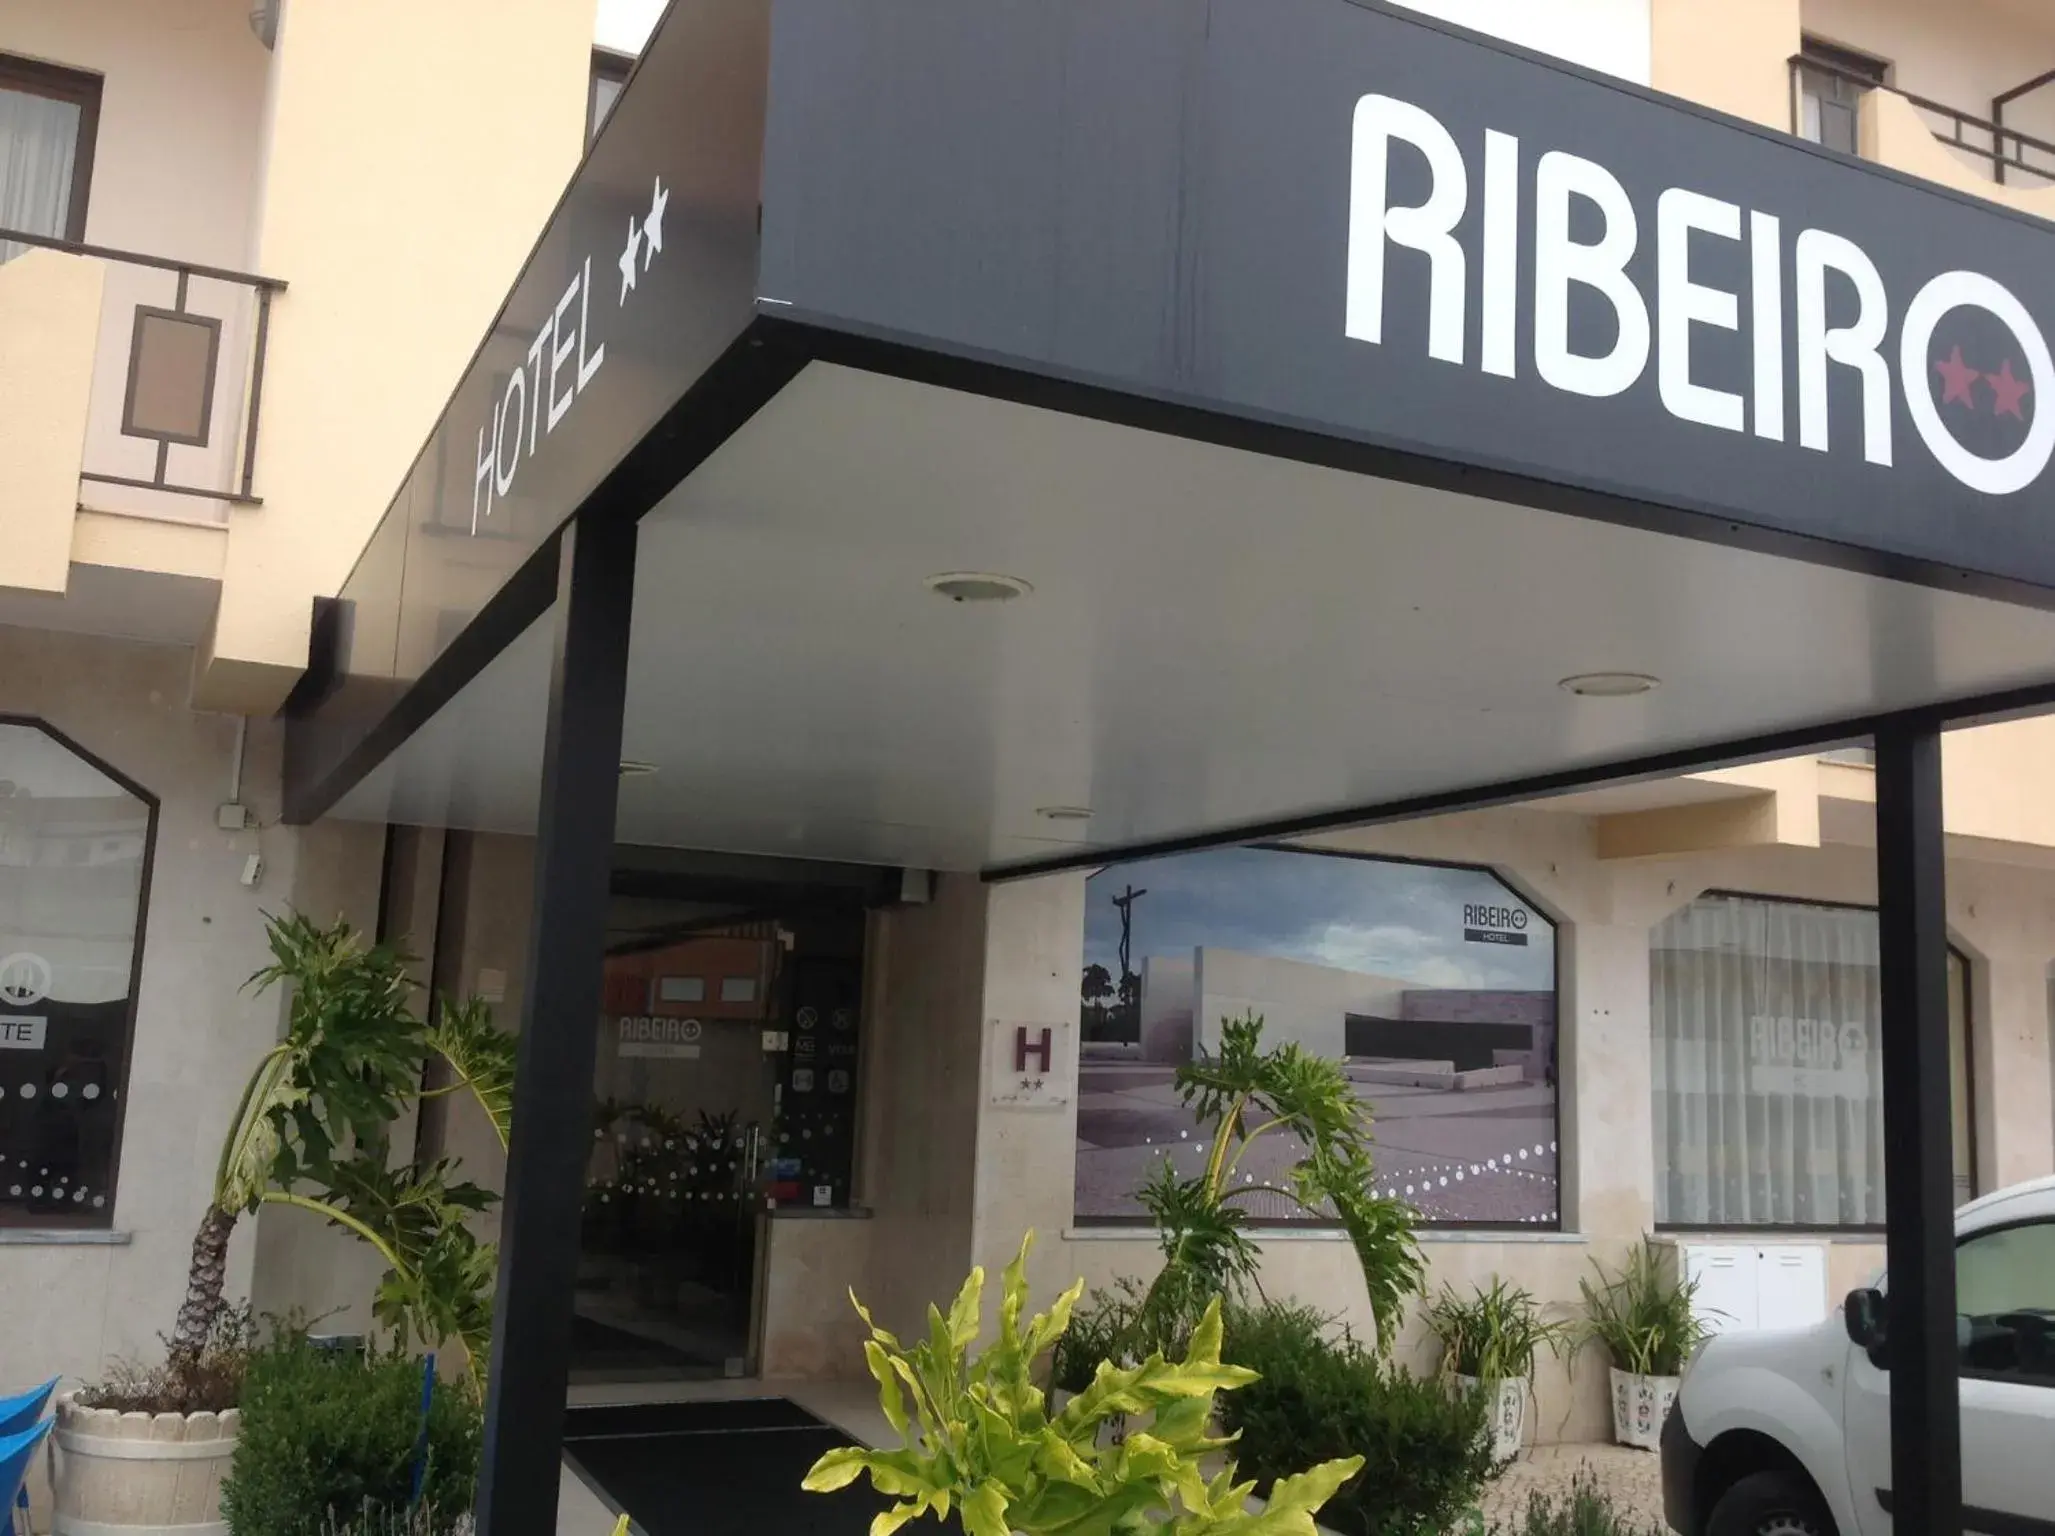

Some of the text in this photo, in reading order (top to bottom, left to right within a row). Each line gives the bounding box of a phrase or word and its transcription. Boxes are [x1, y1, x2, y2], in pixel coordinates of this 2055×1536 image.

[1345, 92, 2055, 496] RIBEIRO
[471, 255, 604, 536] HOTEL
[1464, 904, 1527, 929] RIBEIRO
[1482, 932, 1511, 942] HOTEL
[621, 1016, 702, 1042] RIBEIRO
[1017, 1026, 1051, 1072] H
[1751, 1015, 1867, 1059] RIBEIRO
